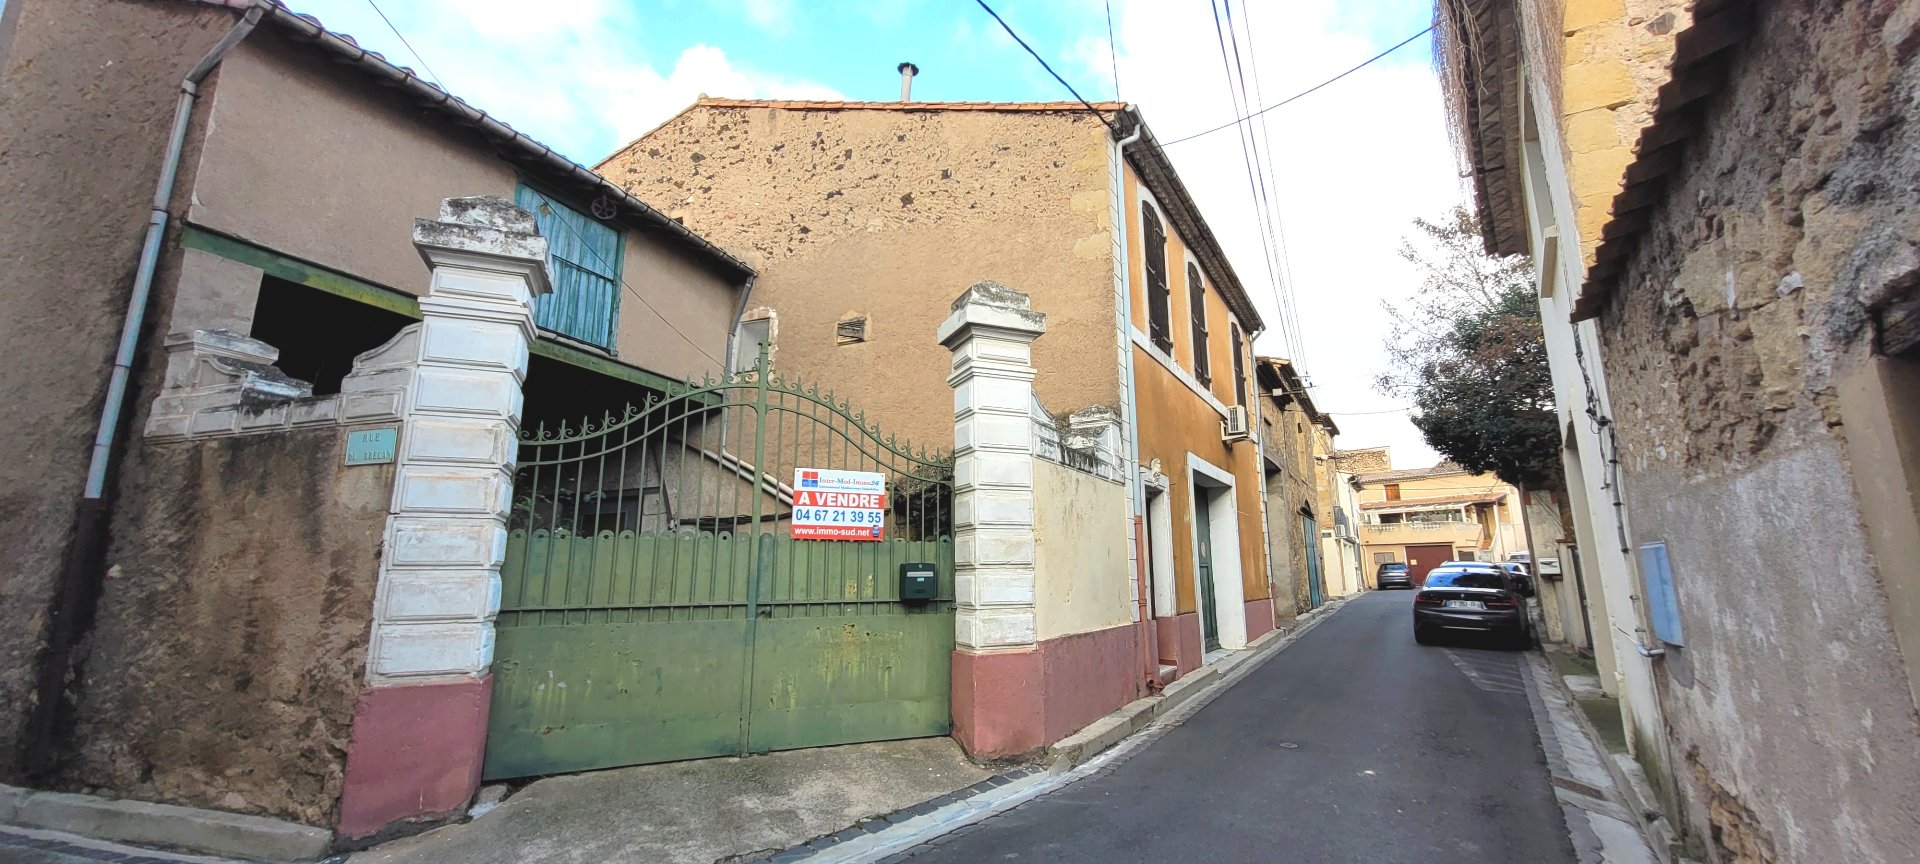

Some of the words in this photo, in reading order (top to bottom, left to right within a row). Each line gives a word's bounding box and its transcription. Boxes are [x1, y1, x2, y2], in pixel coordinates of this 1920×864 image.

[362, 432, 381, 443] RUE
[798, 491, 811, 505] A
[815, 492, 880, 508] VENDRE
[795, 508, 811, 521] 04
[814, 509, 829, 521] 67
[832, 510, 846, 522] 21
[850, 510, 864, 523] 39
[867, 511, 882, 523] 55
[794, 526, 870, 537] www.immo-sud.net
